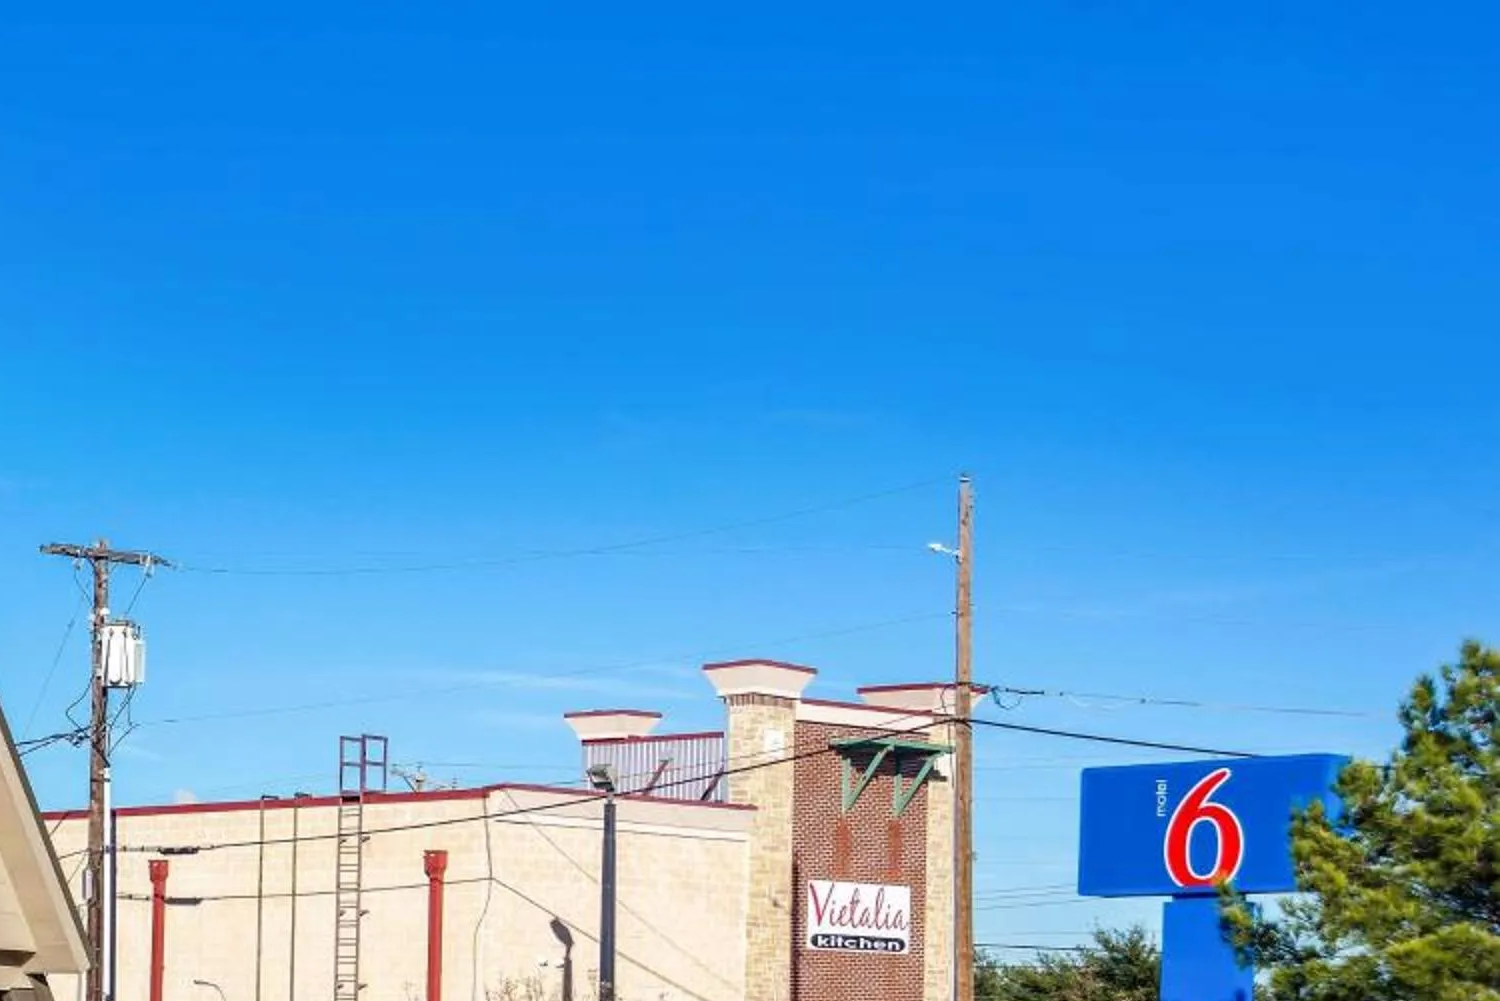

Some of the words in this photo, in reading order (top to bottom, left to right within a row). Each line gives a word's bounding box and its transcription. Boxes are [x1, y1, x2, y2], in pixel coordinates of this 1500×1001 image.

[1163, 767, 1244, 888] 6
[809, 882, 908, 931] Vietalia
[817, 935, 901, 951] kitchen
